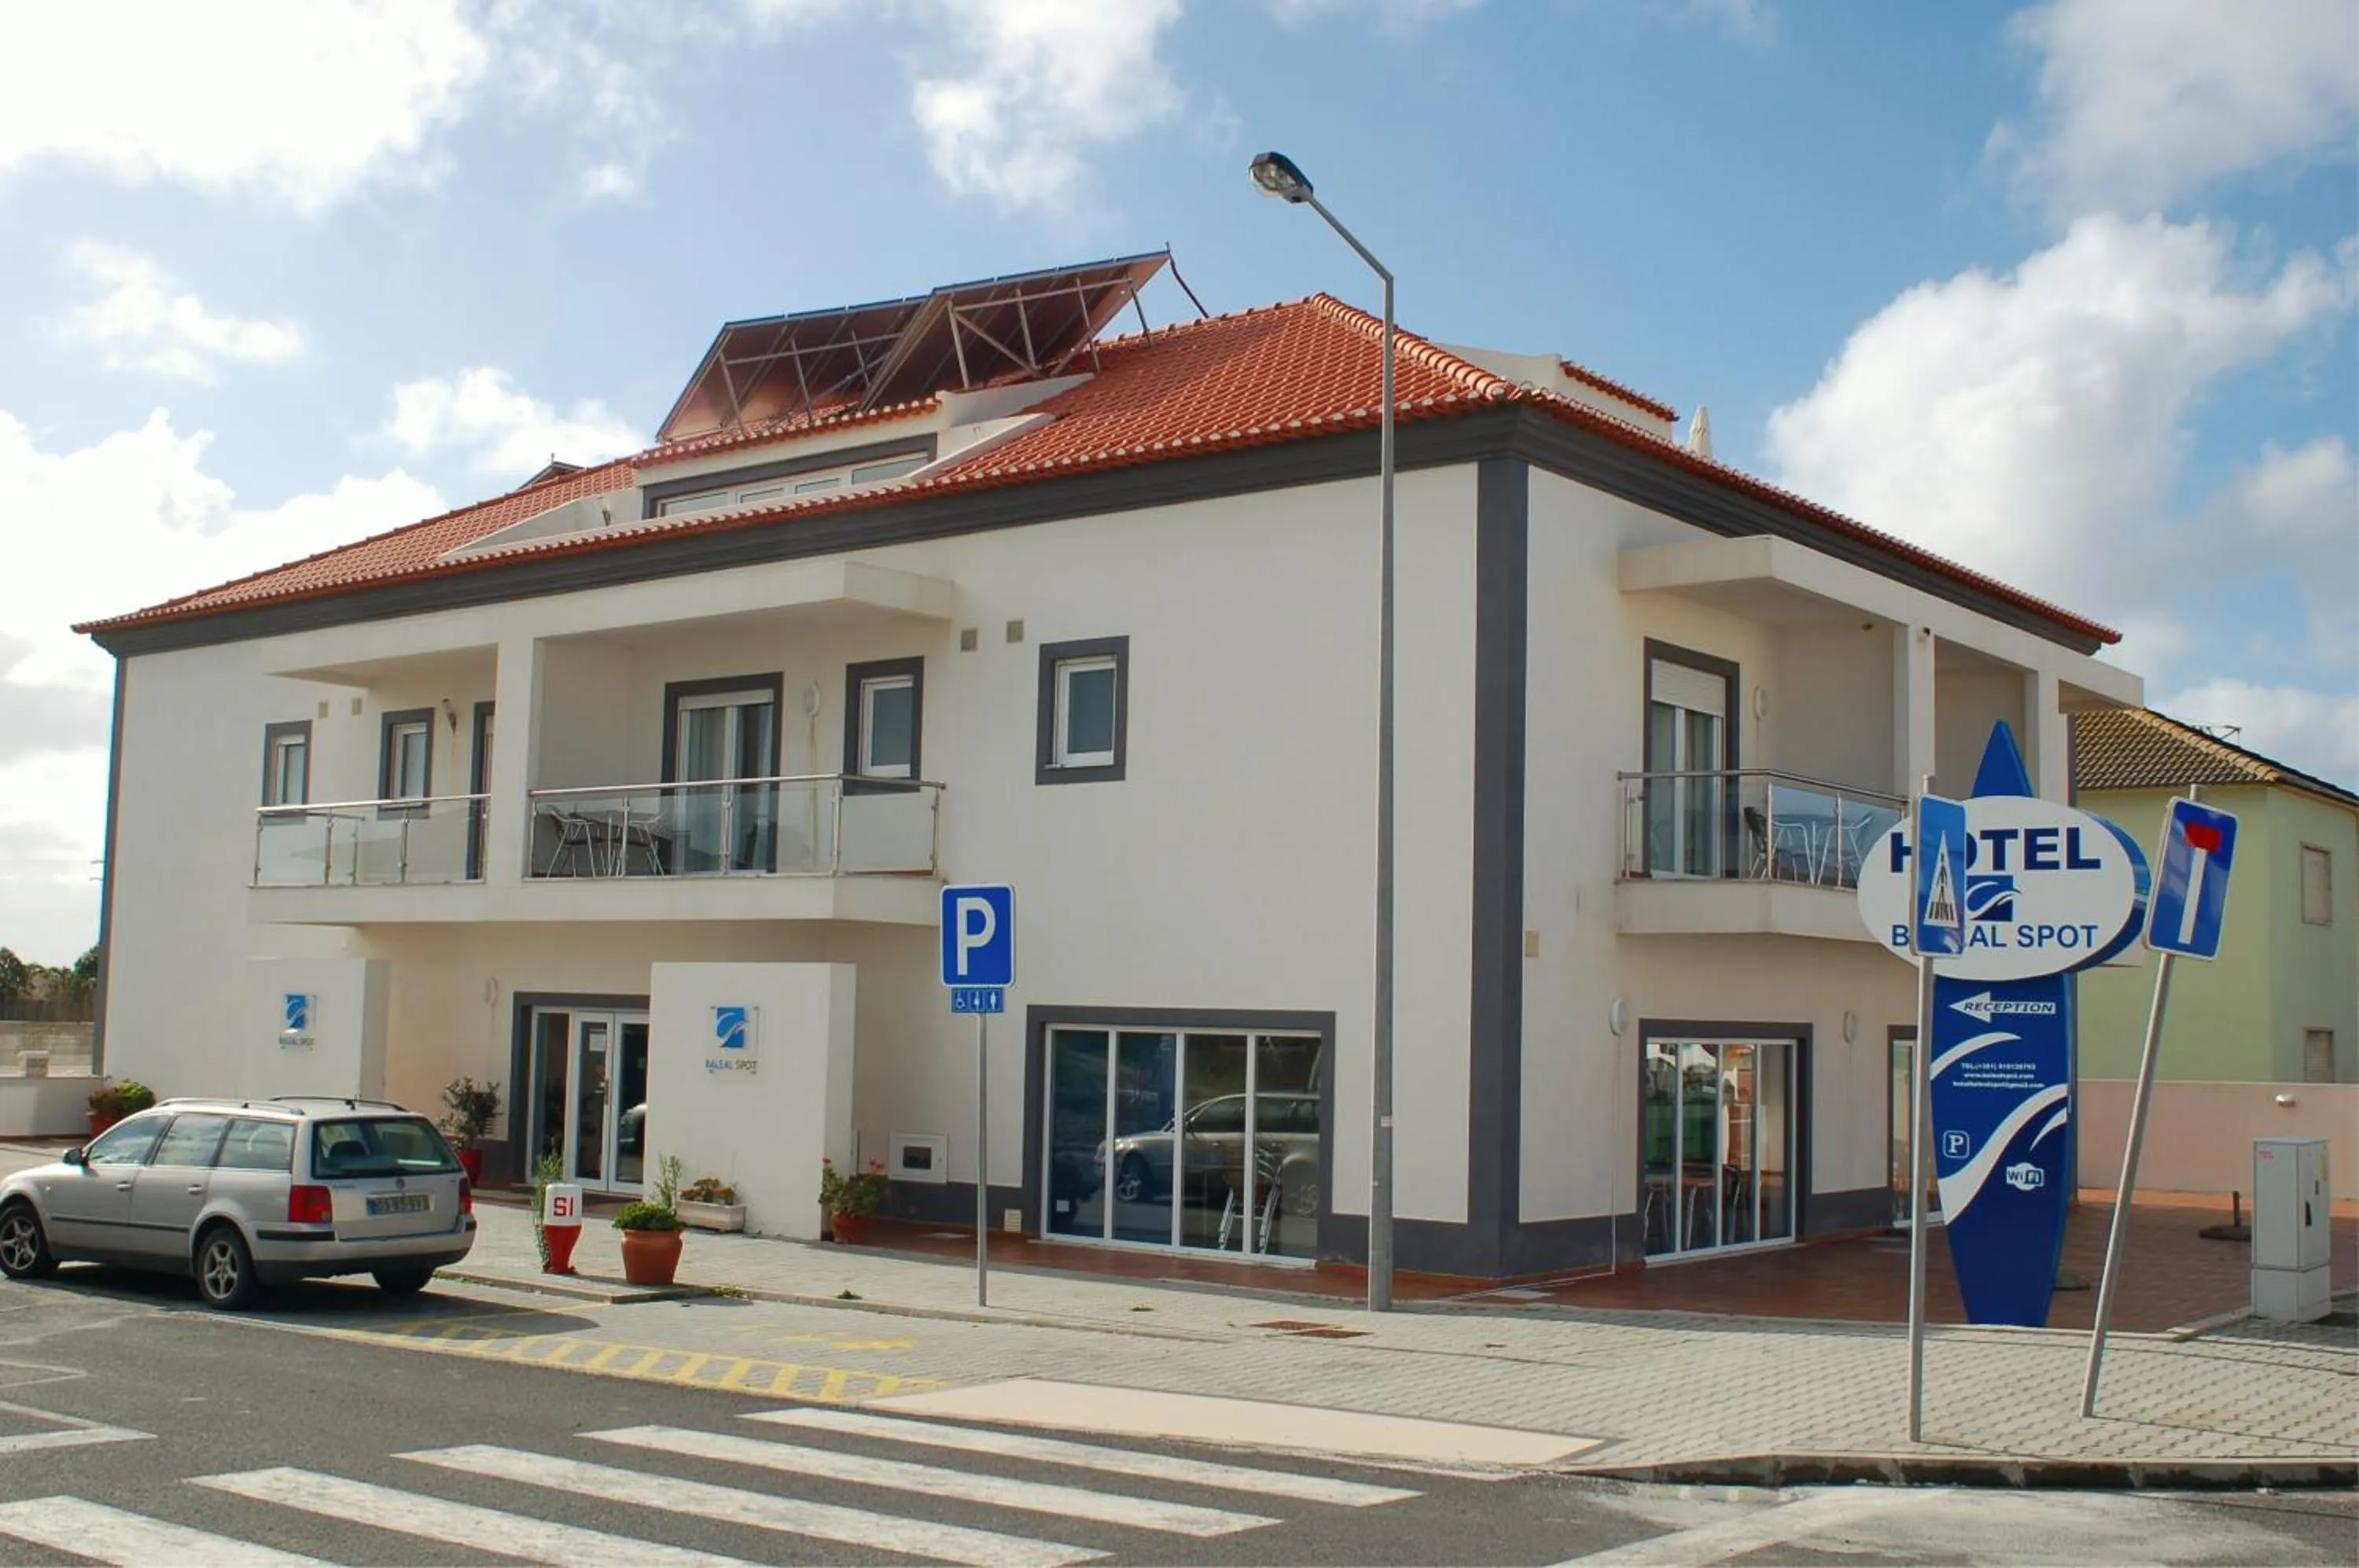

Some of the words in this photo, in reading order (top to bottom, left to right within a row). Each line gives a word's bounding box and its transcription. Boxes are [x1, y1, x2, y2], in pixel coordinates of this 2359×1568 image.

[1890, 826, 2102, 874] HTEL
[956, 896, 996, 976] P
[1892, 924, 2008, 948] BAL
[2016, 924, 2100, 949] SPOT
[1963, 1001, 2054, 1013] RECEPTION
[1948, 1134, 1964, 1154] P
[554, 1196, 573, 1216] SI
